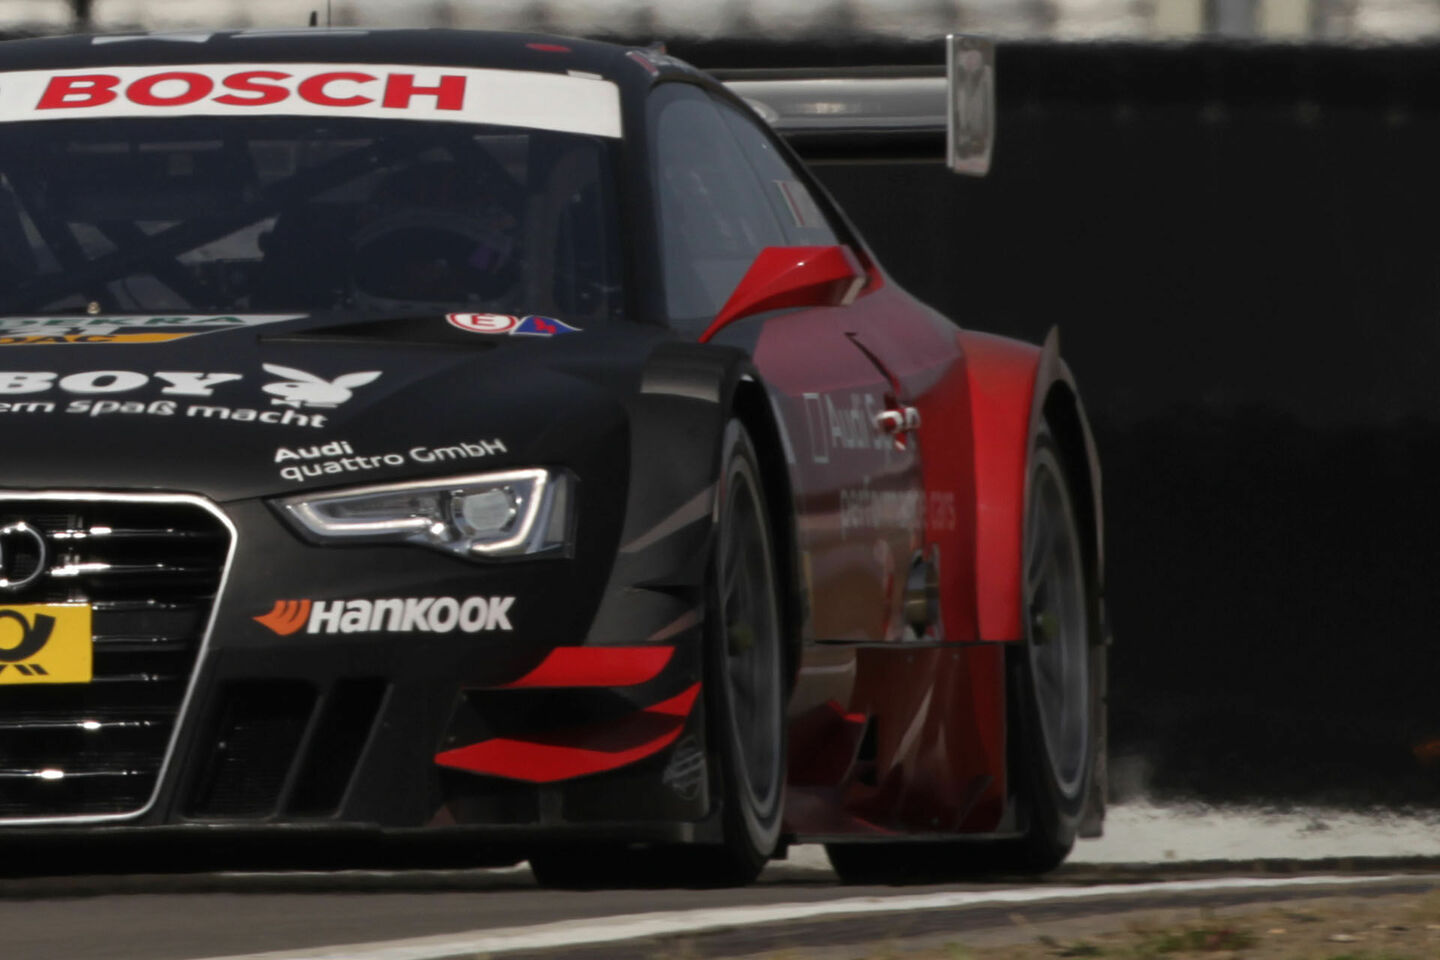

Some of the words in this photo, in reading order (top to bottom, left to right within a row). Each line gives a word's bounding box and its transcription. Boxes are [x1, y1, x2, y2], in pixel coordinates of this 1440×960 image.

[35, 69, 469, 111] BOSCH
[186, 403, 329, 428] macht
[274, 440, 355, 464] Audi
[280, 452, 404, 482] quattro
[409, 437, 508, 463] GmbH
